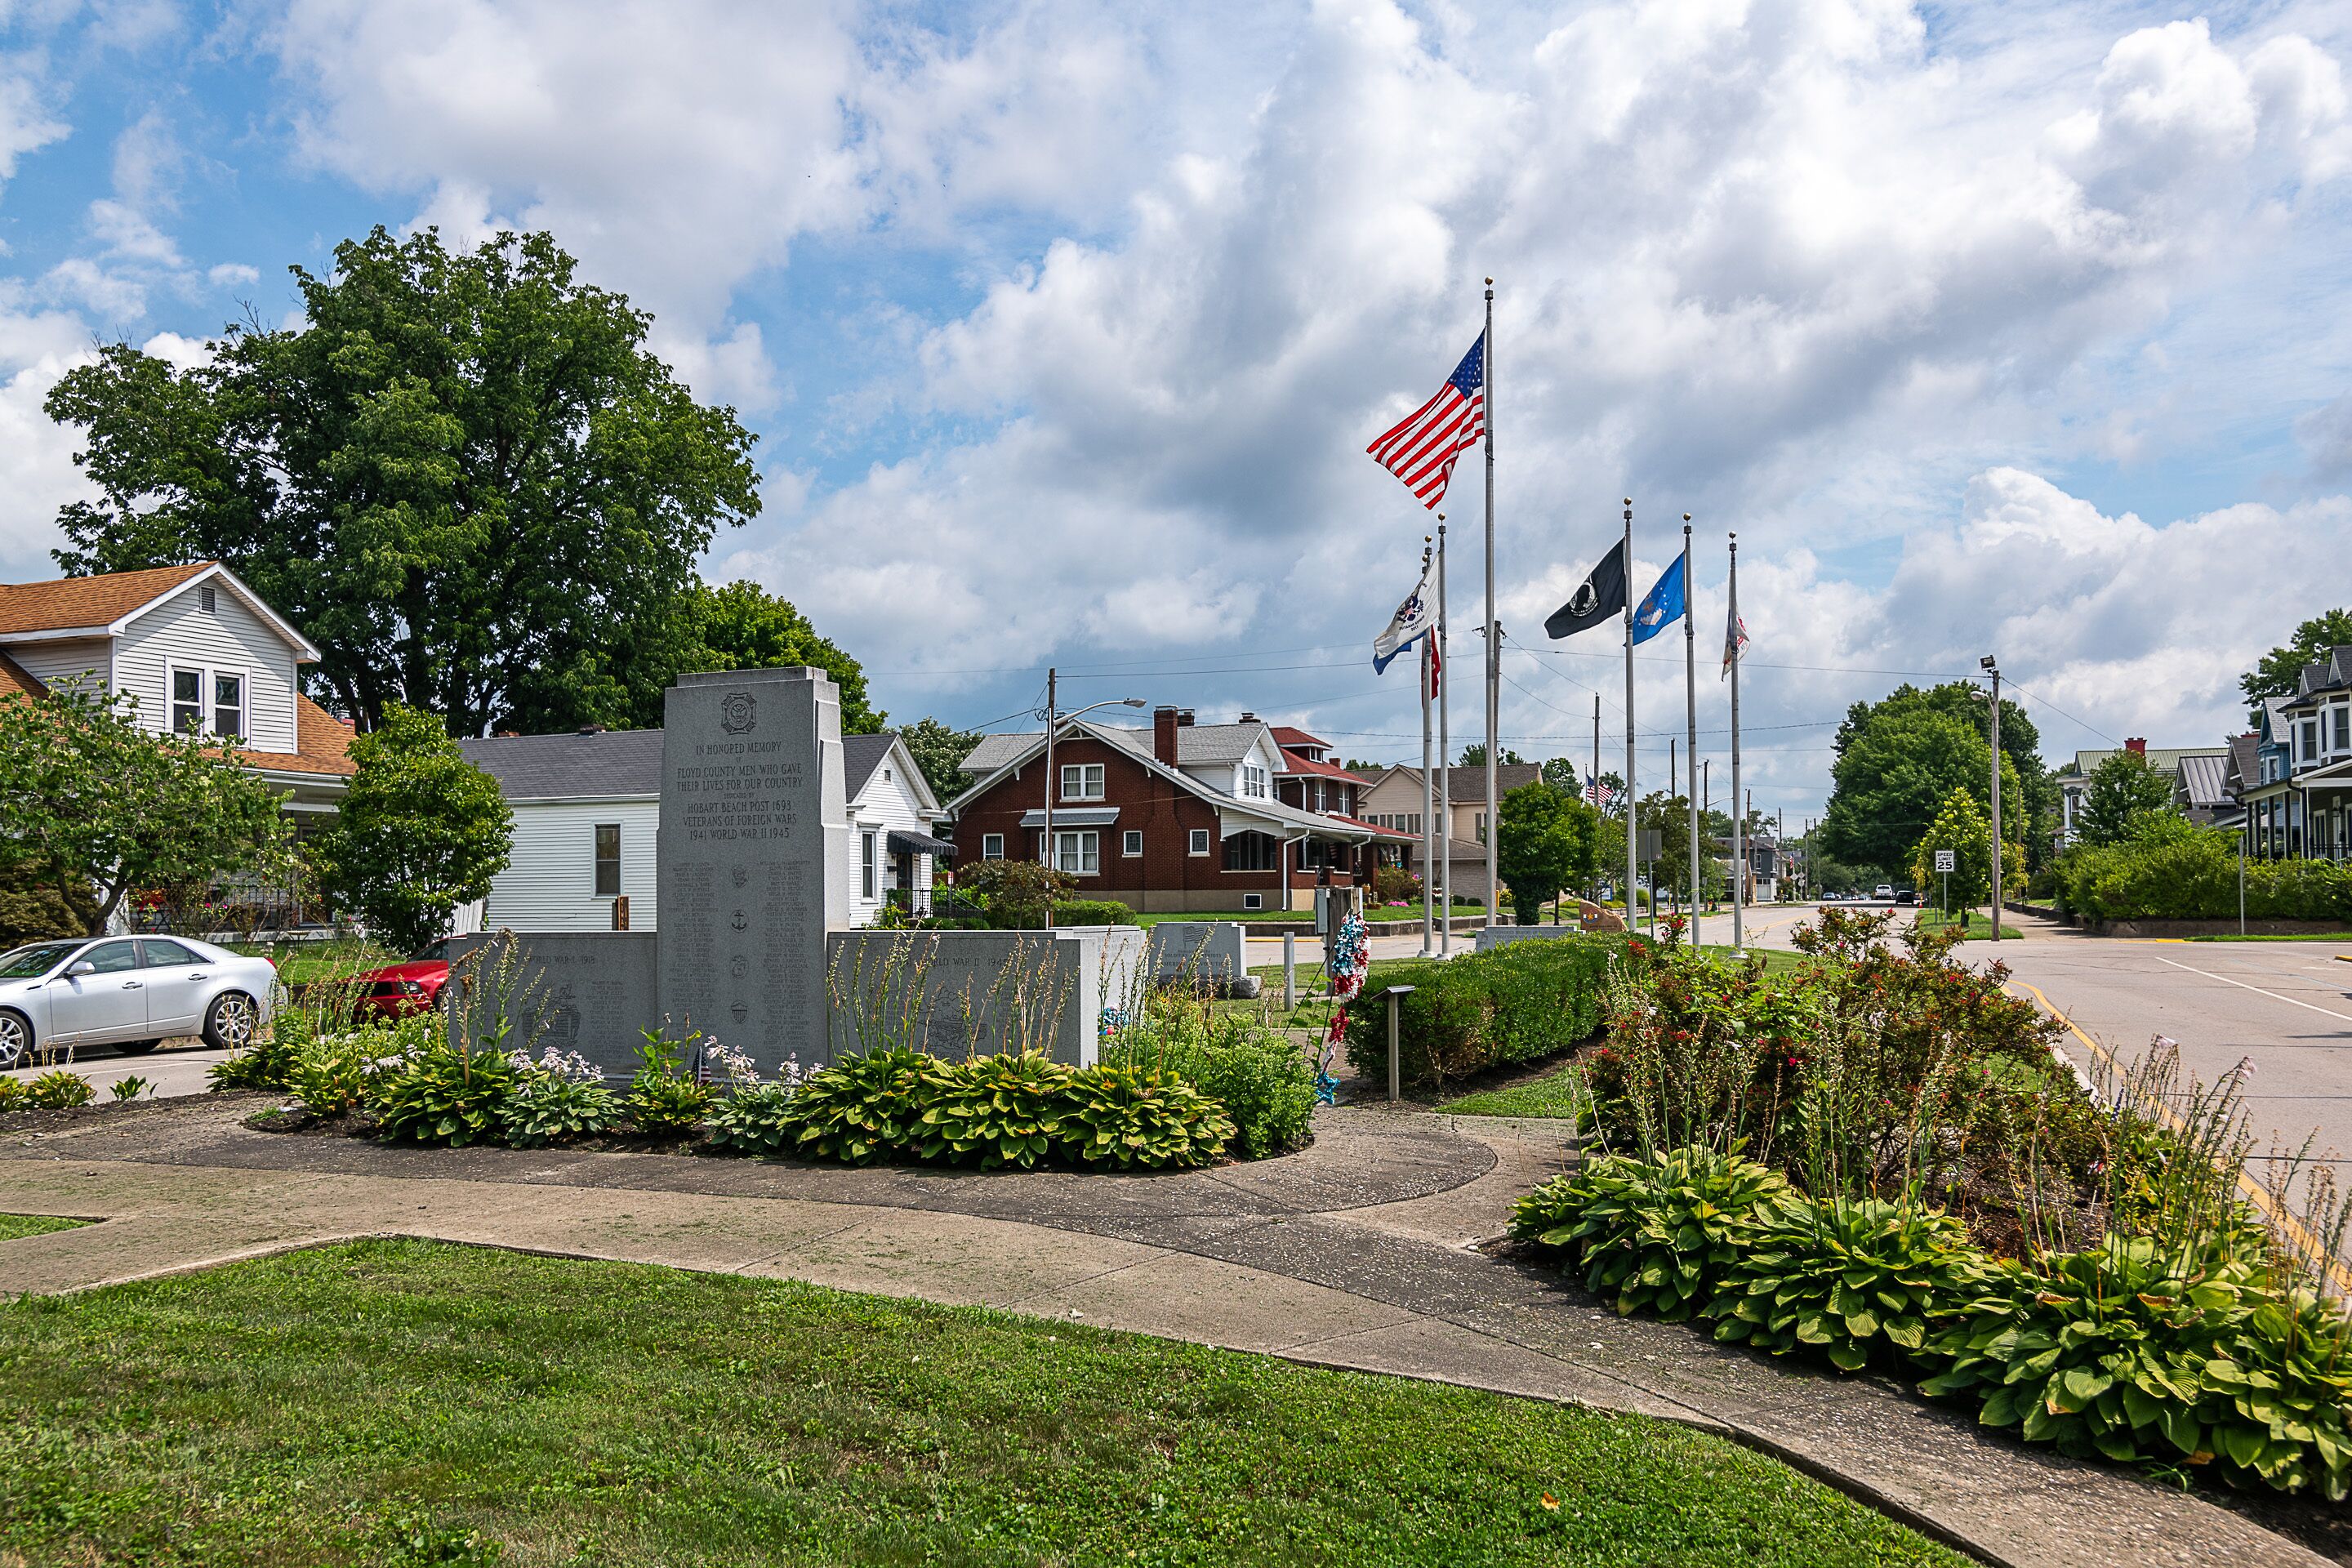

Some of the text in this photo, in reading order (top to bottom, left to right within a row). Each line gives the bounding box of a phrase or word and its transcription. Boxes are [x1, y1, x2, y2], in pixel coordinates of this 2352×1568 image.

[696, 742, 782, 755] IN HONORED MEMORY
[677, 763, 802, 778] FLOYD COUNTY MEN WHO GAVE
[677, 777, 803, 792] THEIR LIVES FOR OUR COUNTRY
[688, 800, 791, 814] HOBART BEACH POST 1693
[683, 813, 797, 827] VETERANS OF FOREIGN WARS
[690, 827, 790, 840] 1941 WORLD WAR II 1945
[555, 956, 569, 964] WAR
[581, 956, 595, 964] 1918
[952, 957, 970, 966] WAR
[974, 957, 980, 966] II
[987, 957, 1009, 967] 1945
